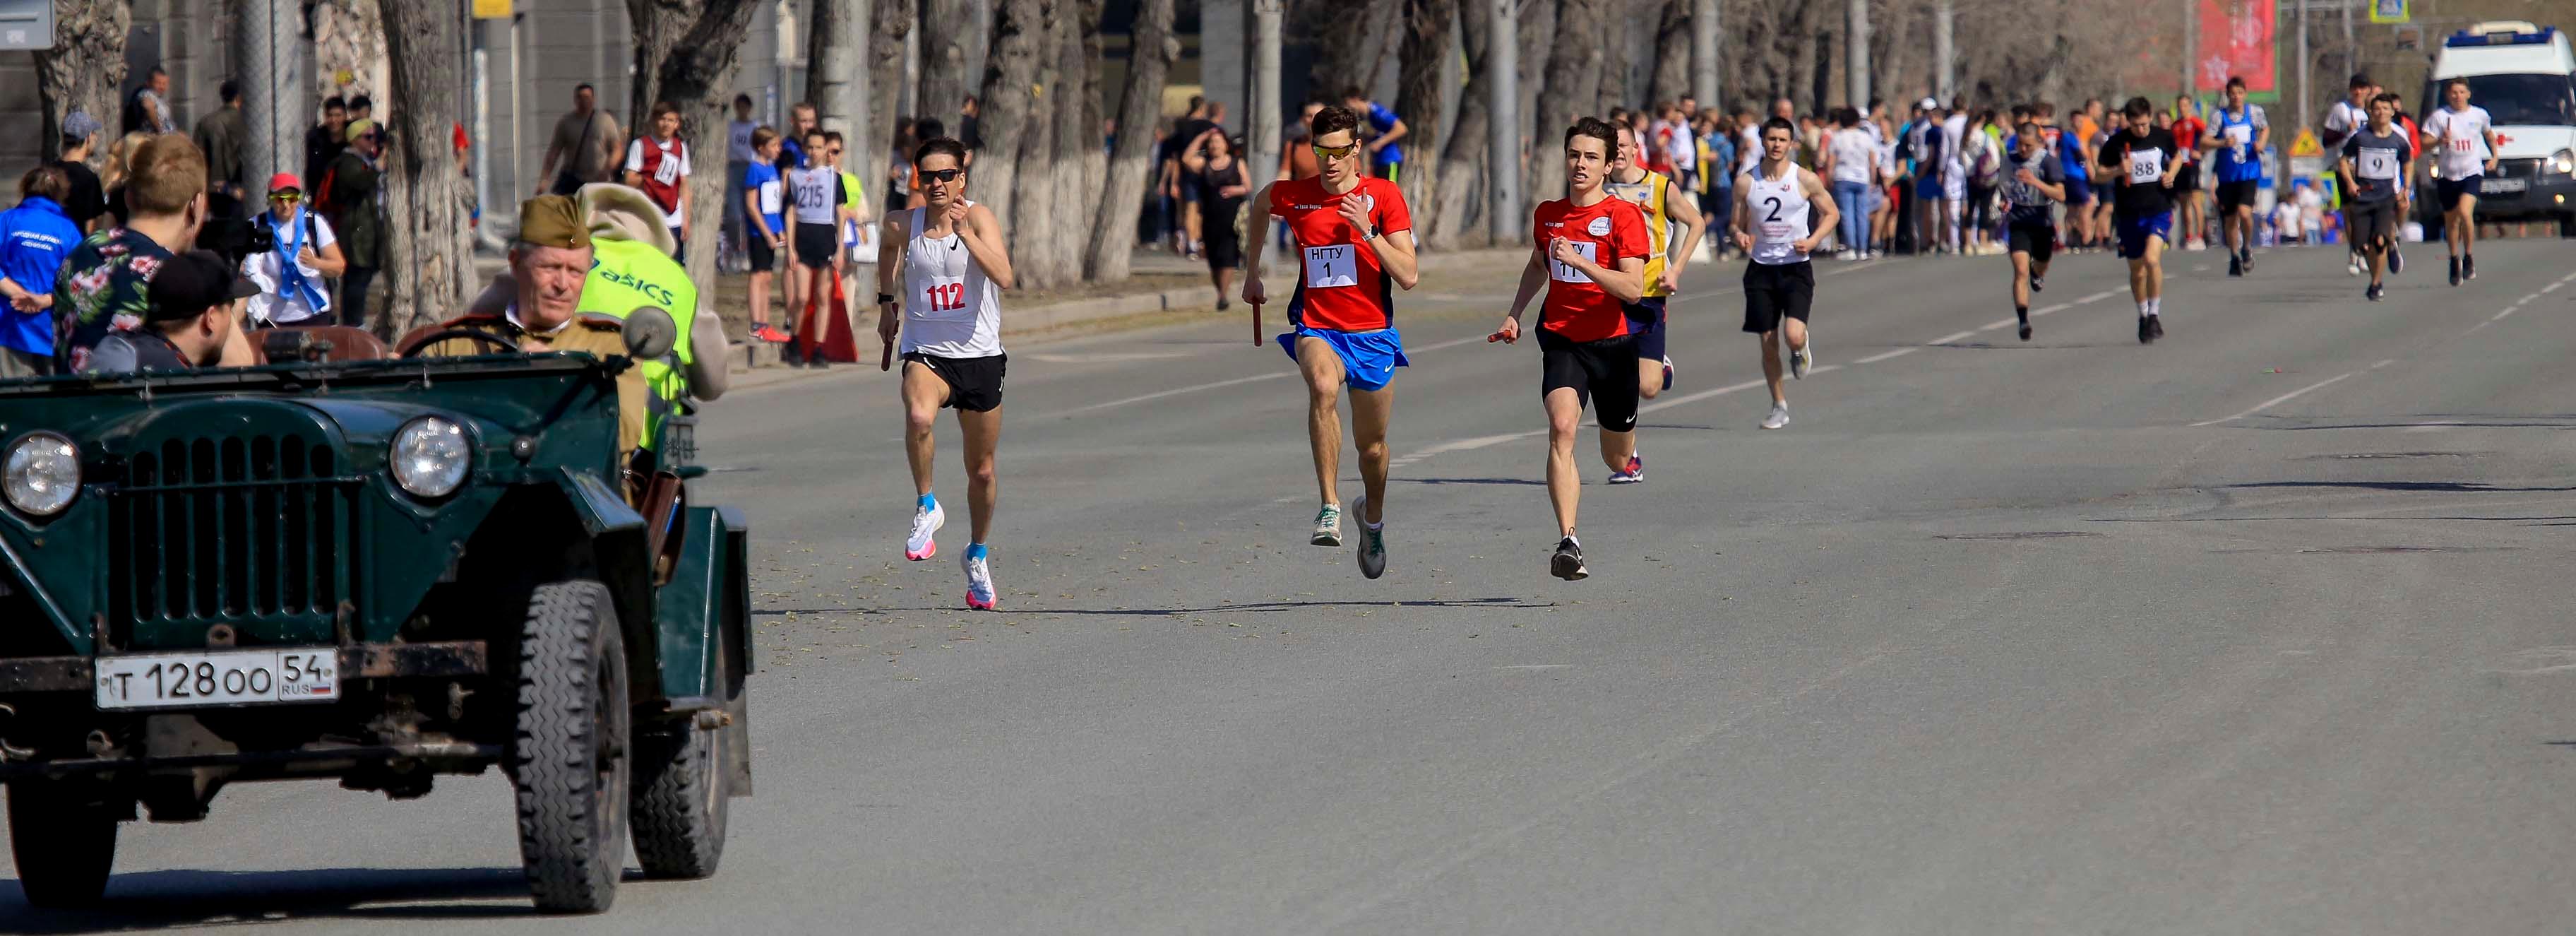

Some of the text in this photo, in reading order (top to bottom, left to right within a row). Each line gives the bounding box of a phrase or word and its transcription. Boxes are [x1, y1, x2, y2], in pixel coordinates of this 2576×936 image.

[2135, 162, 2155, 177] 88
[2373, 158, 2383, 171] 9
[798, 185, 823, 208] 215
[1763, 196, 1782, 223] 2
[1311, 247, 1344, 261] НГТУ
[1323, 261, 1332, 278] 1
[926, 283, 966, 312] 112
[283, 654, 321, 682] 54
[282, 684, 310, 695] RUS
